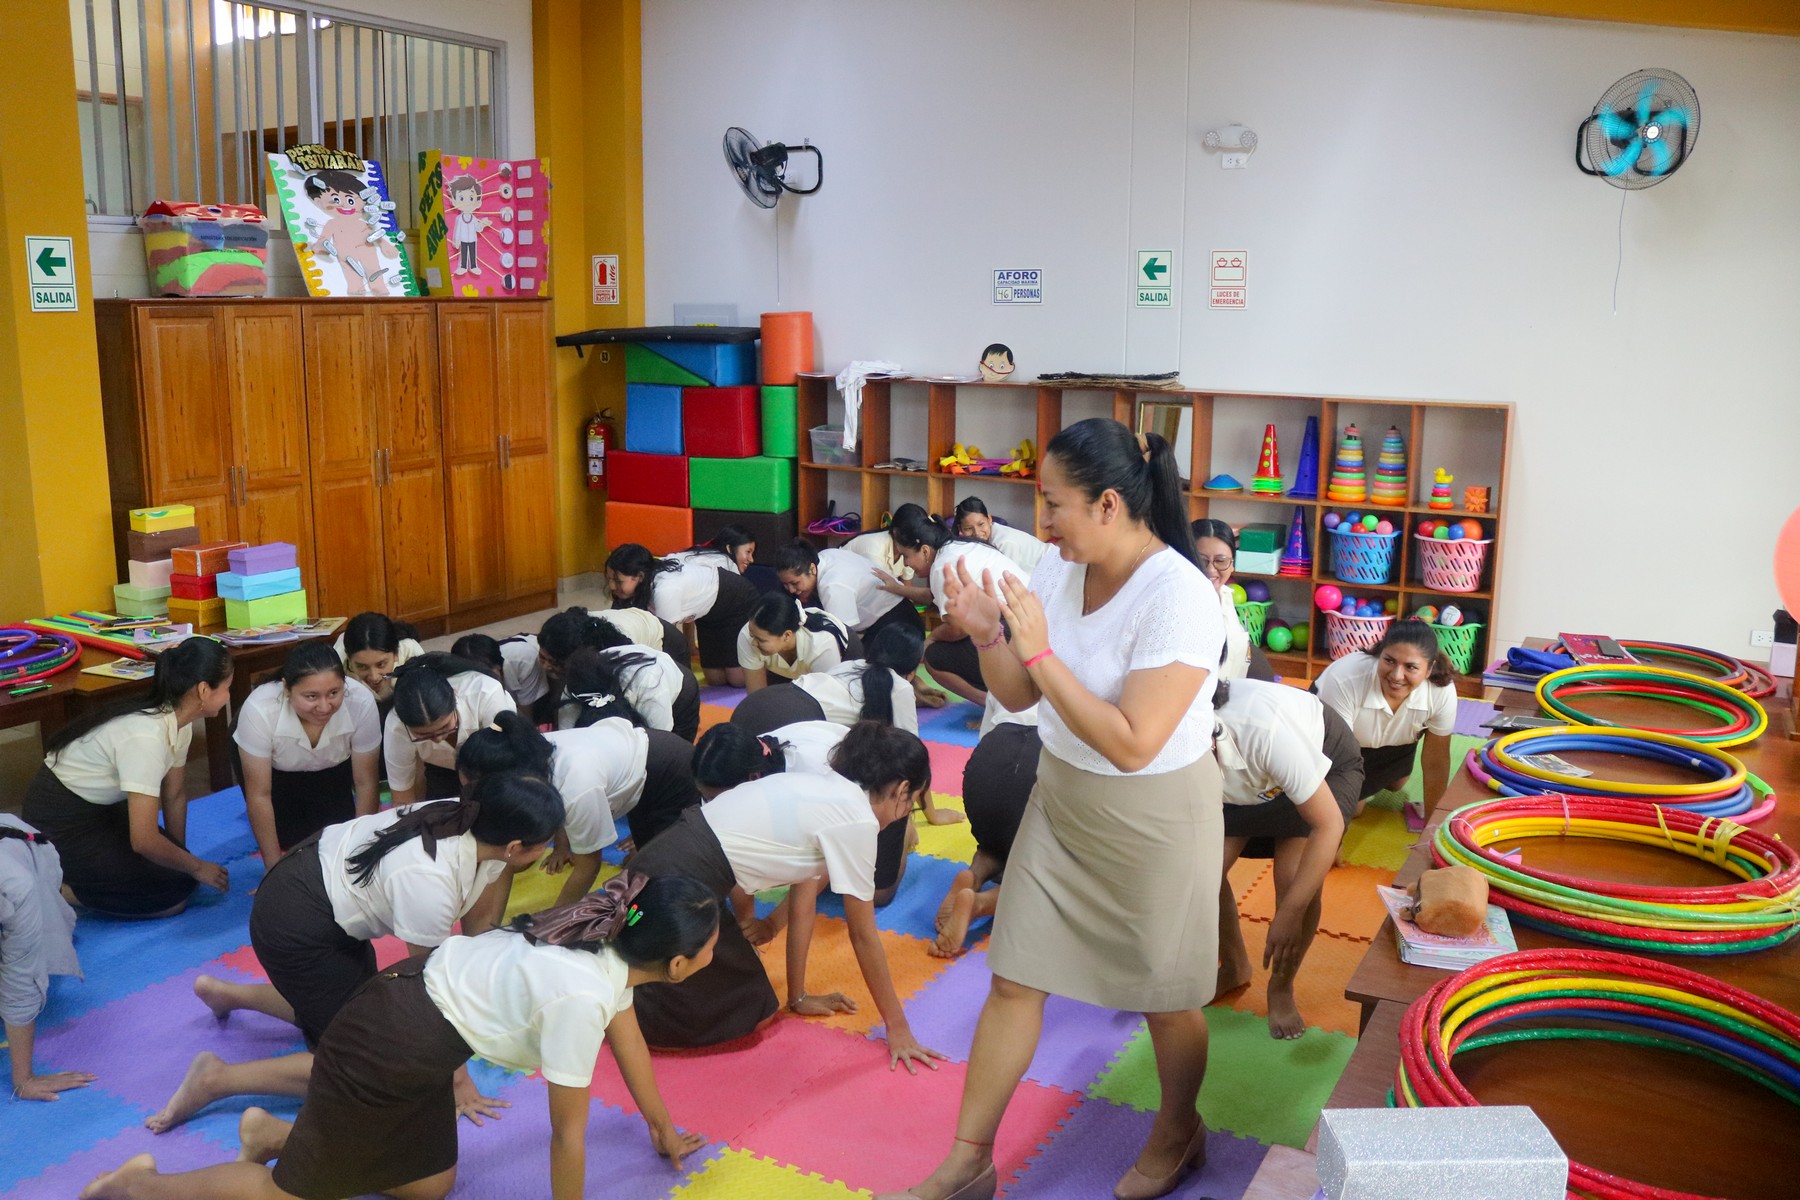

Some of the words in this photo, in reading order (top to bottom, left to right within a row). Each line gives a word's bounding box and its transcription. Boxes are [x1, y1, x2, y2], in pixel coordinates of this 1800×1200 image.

[998, 271, 1038, 280] AFORO
[36, 291, 73, 304] SALIDA
[1013, 288, 1040, 299] PERSONAS
[1139, 292, 1168, 302] SALIDA
